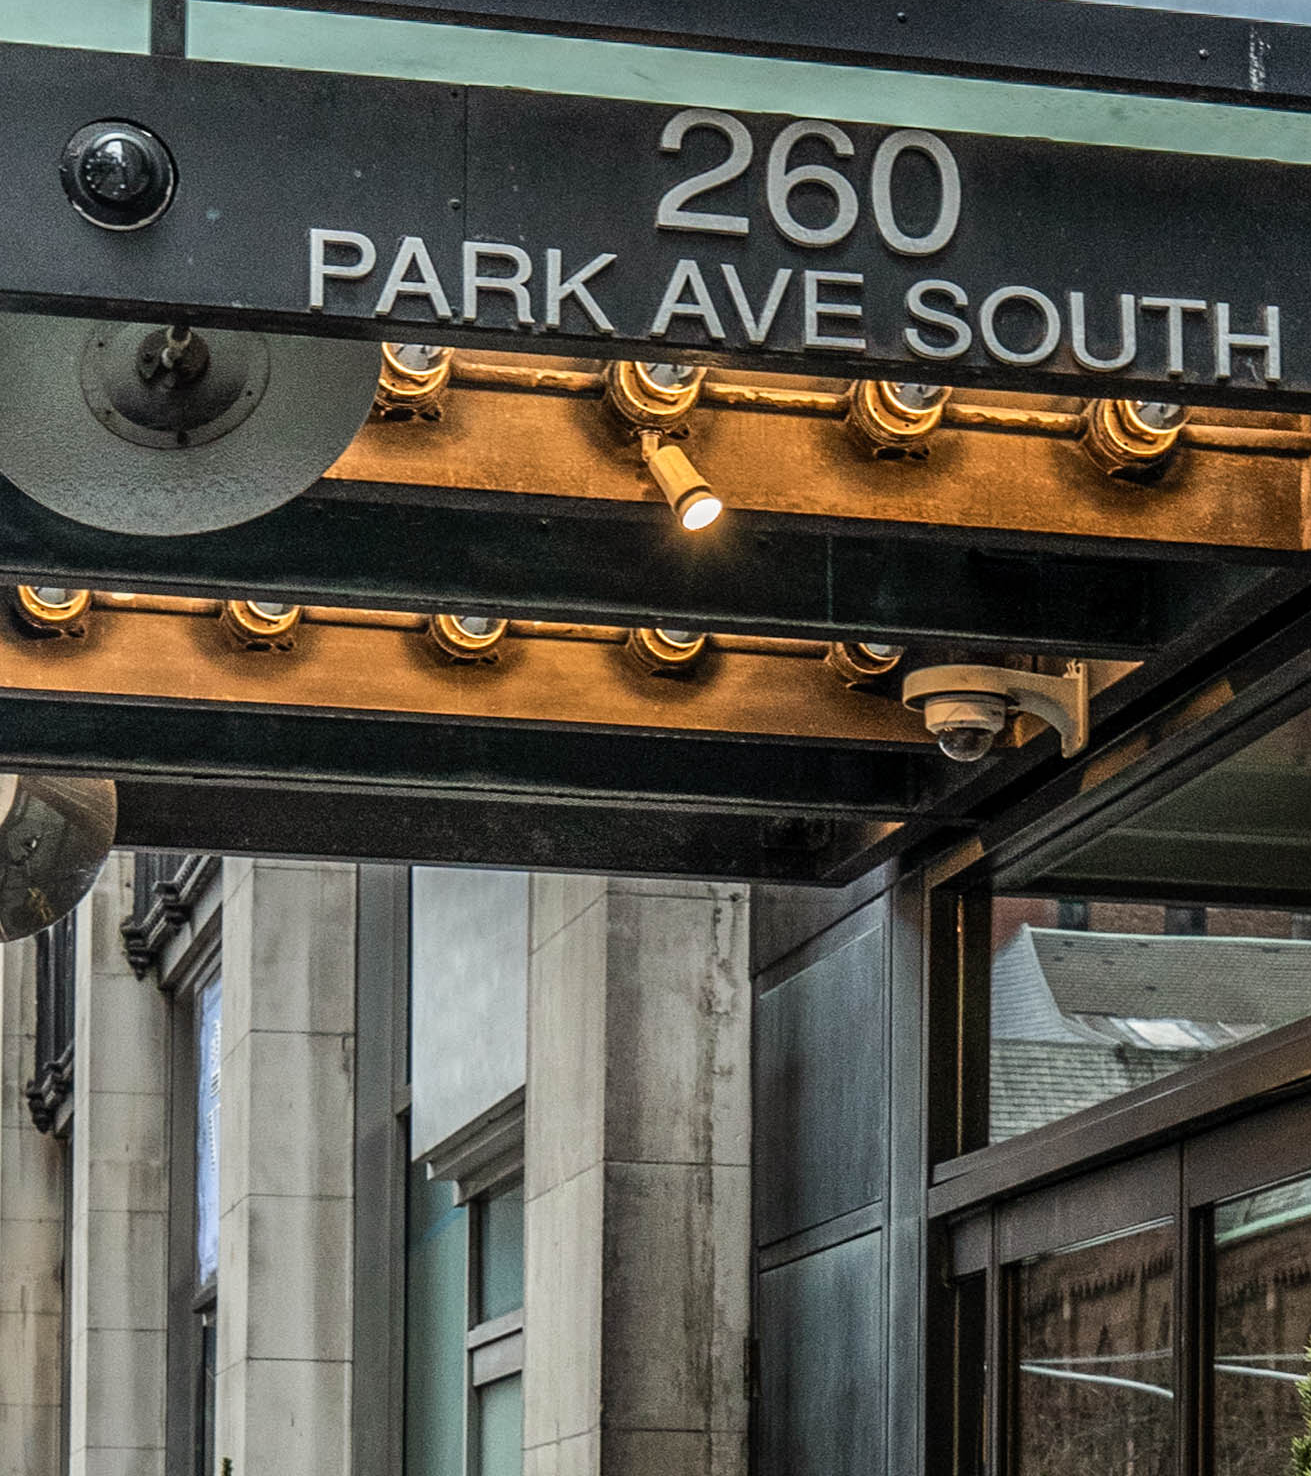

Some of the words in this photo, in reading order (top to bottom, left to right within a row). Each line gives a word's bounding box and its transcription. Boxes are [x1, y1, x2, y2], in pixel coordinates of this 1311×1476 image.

[656, 108, 961, 257] 260
[308, 228, 616, 335] PARK
[650, 258, 868, 352] AVE
[902, 278, 1282, 383] SOUTH
